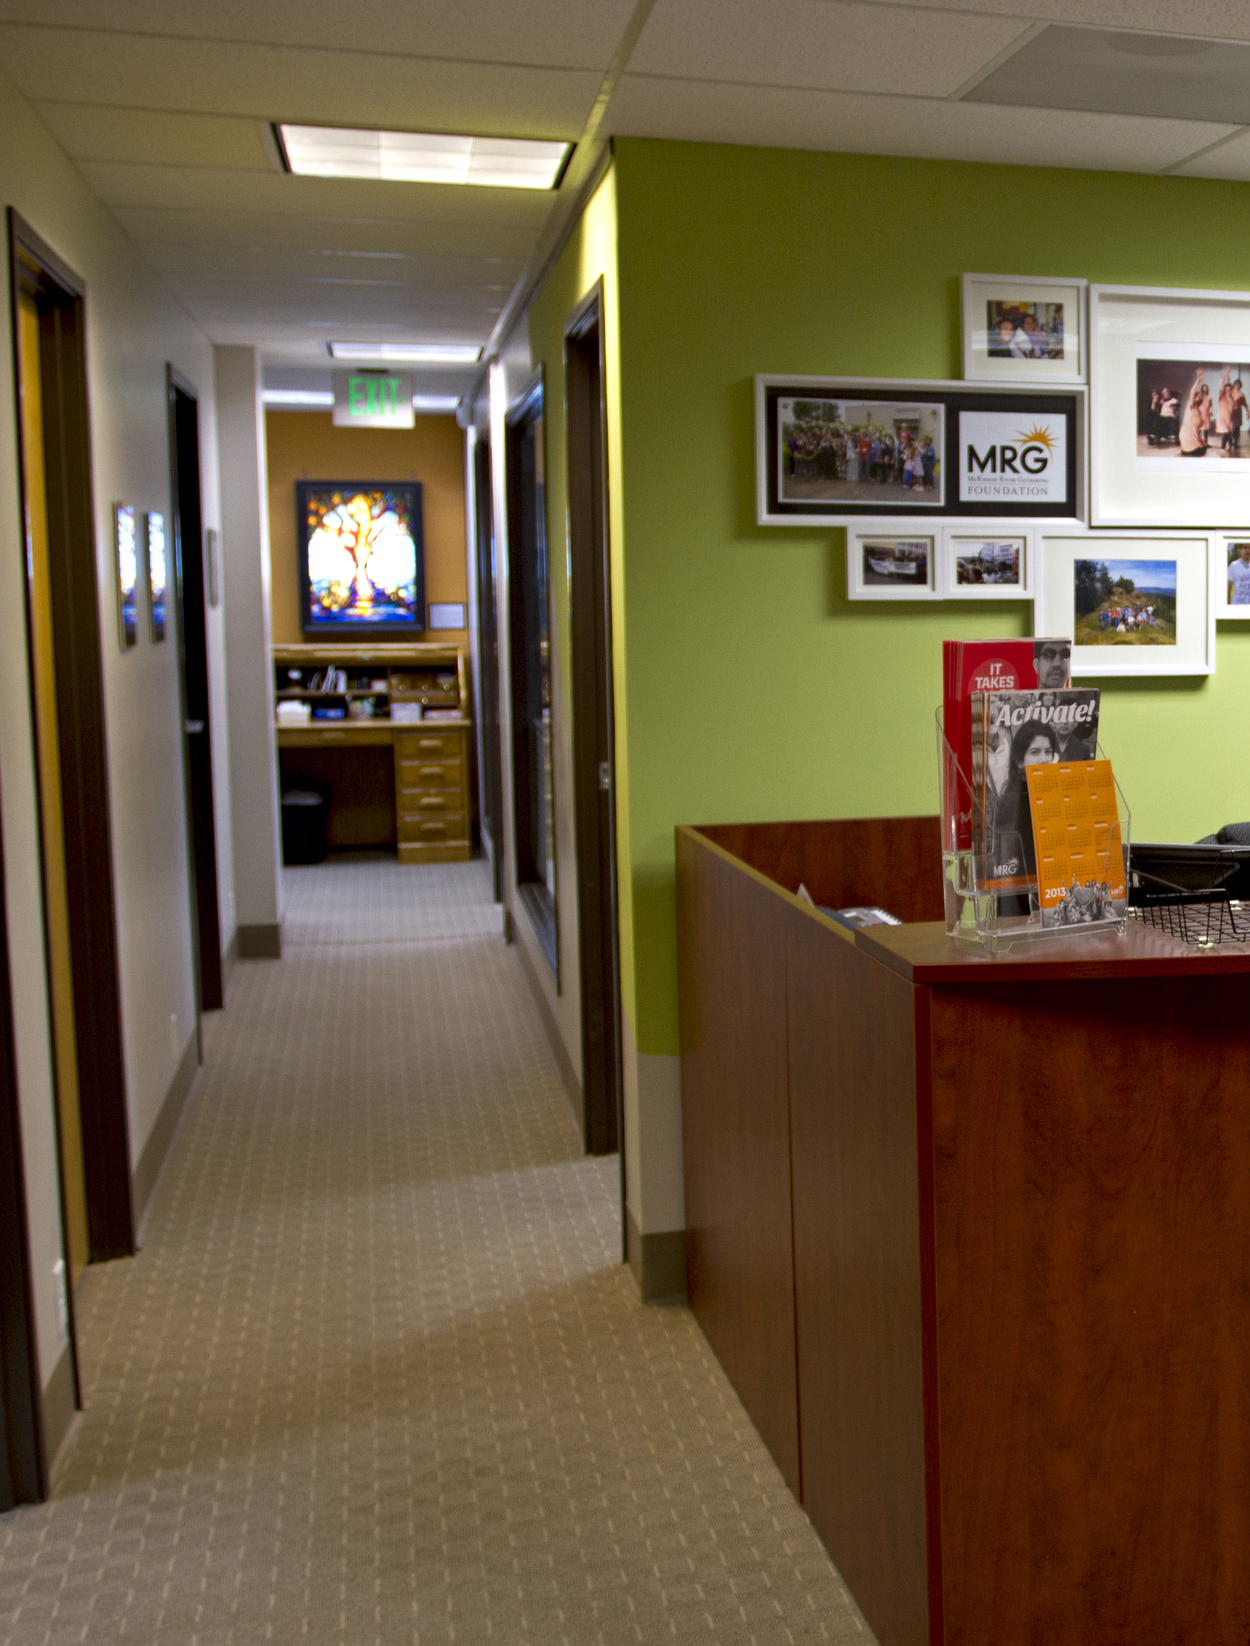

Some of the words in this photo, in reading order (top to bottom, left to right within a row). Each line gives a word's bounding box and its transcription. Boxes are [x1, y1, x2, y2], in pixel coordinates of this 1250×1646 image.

[348, 377, 400, 416] EXIT
[967, 444, 1048, 474] MRG
[967, 485, 1048, 495] FOUNDATION
[990, 663, 1002, 675] IT
[975, 675, 1015, 689] TAKES
[995, 699, 1096, 726] Activate!
[993, 864, 1017, 877] MRG
[1045, 887, 1067, 899] 2013
